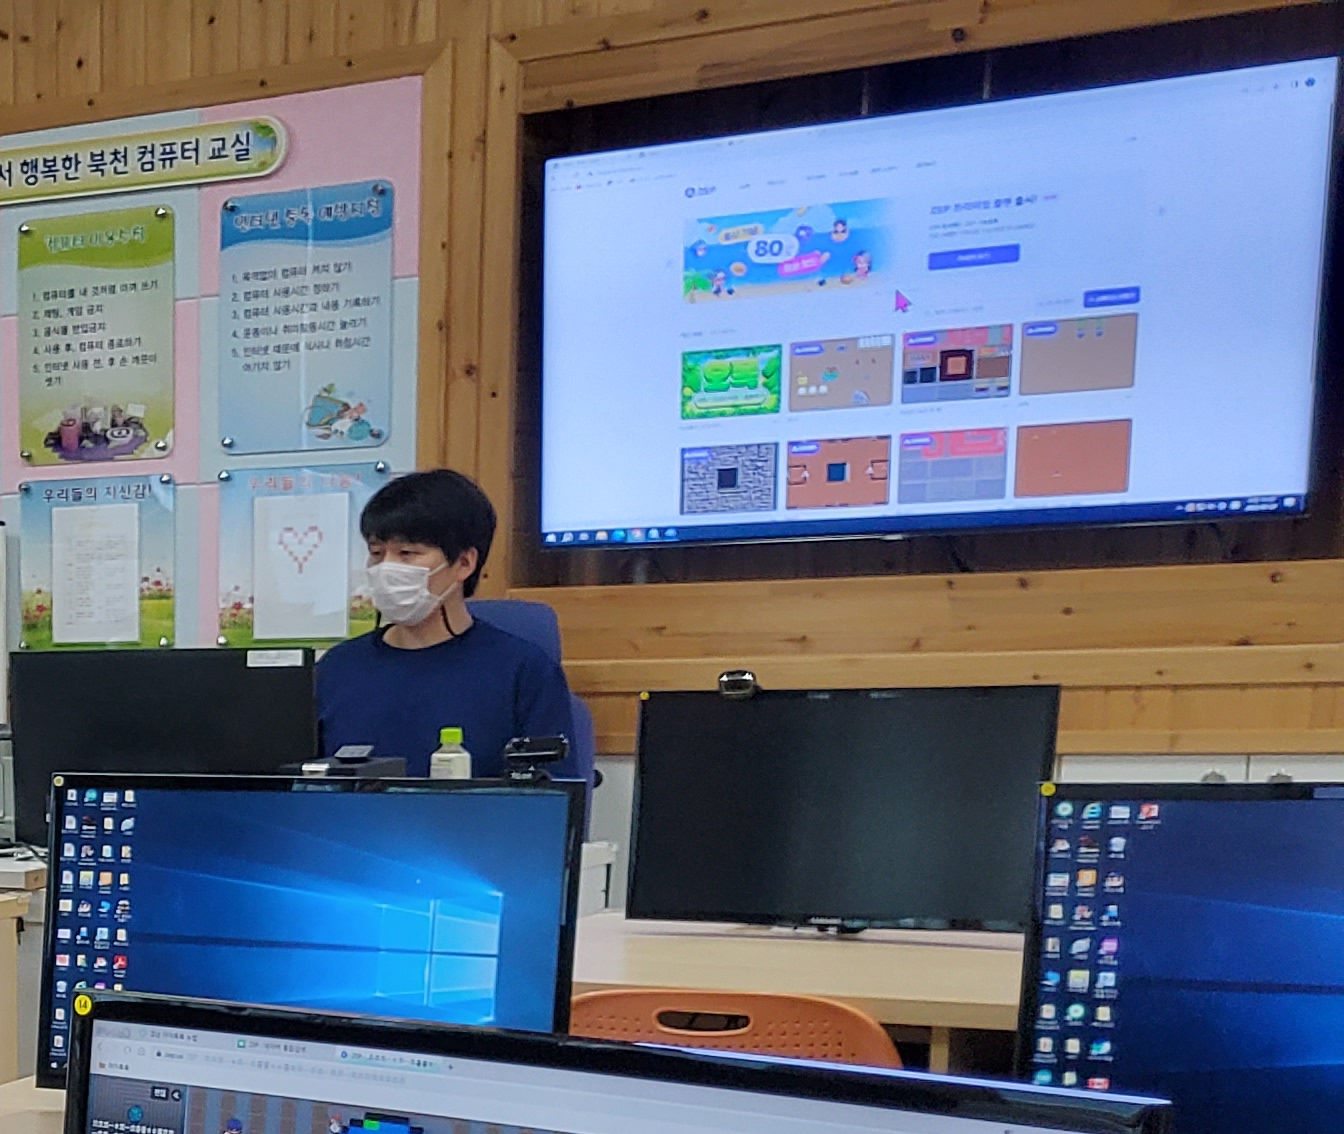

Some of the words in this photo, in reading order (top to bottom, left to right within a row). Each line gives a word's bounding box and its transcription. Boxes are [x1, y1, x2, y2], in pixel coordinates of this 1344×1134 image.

[20, 152, 81, 186] 행복한
[87, 146, 129, 176] 북천
[137, 137, 200, 173] 컴퓨터
[208, 131, 252, 162] 교실
[754, 240, 784, 257] 80
[43, 485, 98, 502] 우리들의
[79, 999, 88, 1009] 14
